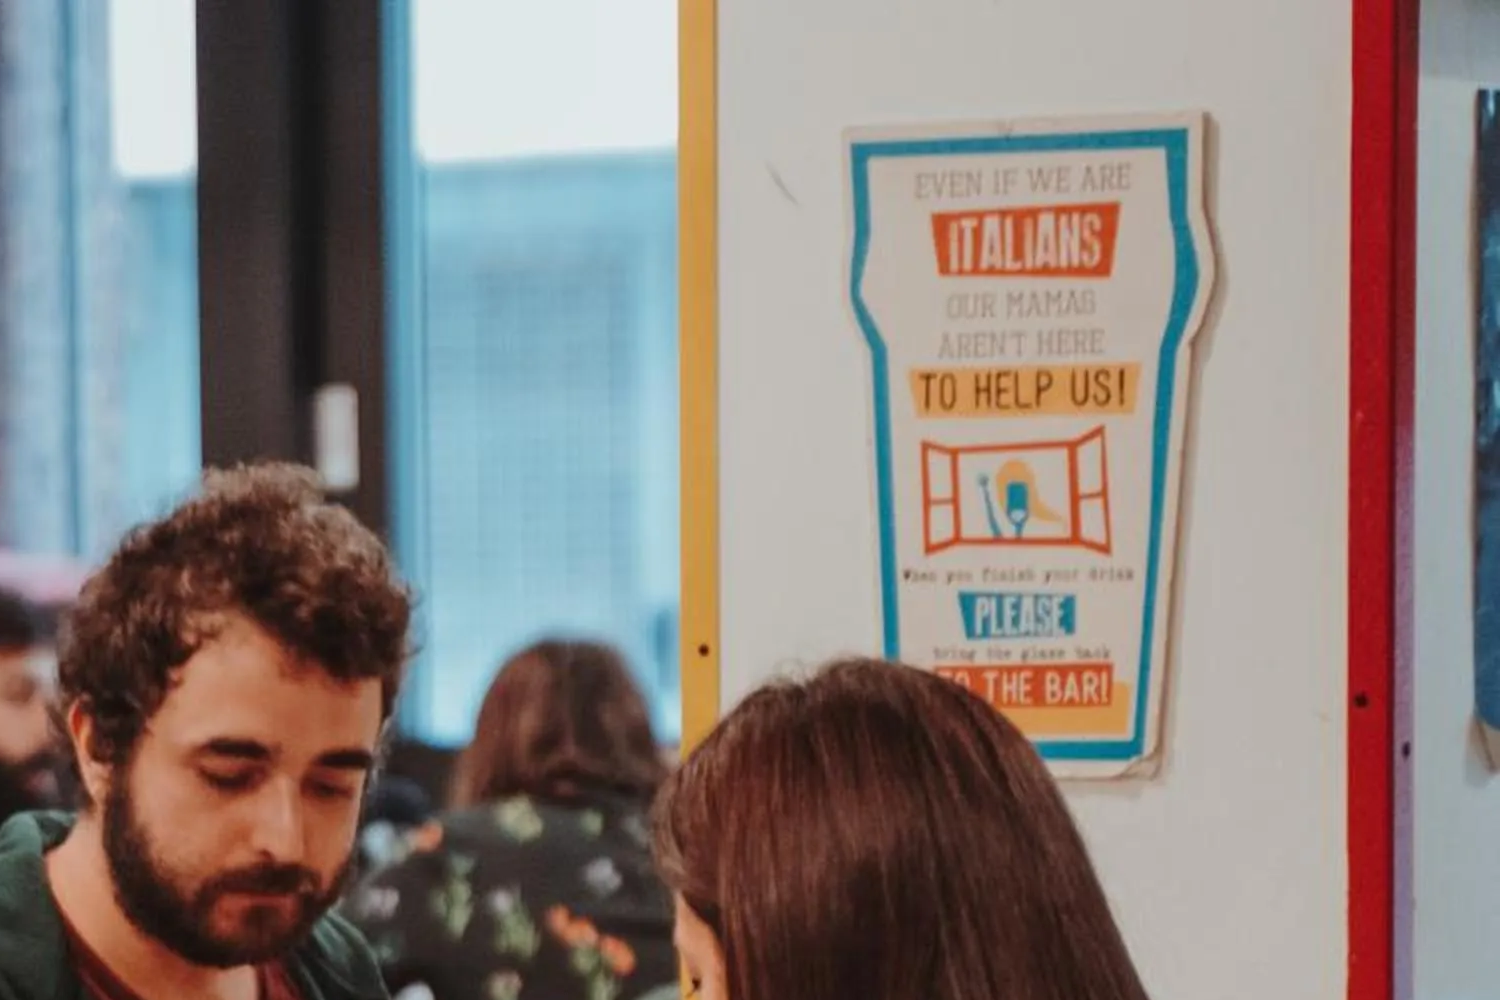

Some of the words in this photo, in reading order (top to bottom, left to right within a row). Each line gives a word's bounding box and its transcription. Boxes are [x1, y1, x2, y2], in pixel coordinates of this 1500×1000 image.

[914, 171, 982, 199] EVEN
[993, 167, 1018, 195] IF
[1027, 165, 1071, 193] WE
[1082, 162, 1132, 192] ARE
[950, 210, 1101, 272] ITALIANS
[947, 292, 996, 320] OUR
[1038, 328, 1105, 356] HERE
[919, 372, 957, 411] TO
[974, 369, 1053, 410] HELP
[1070, 367, 1125, 407] US!
[974, 593, 1066, 637] PLEASE
[983, 670, 1033, 705] THE
[1045, 670, 1108, 705] BAR!
